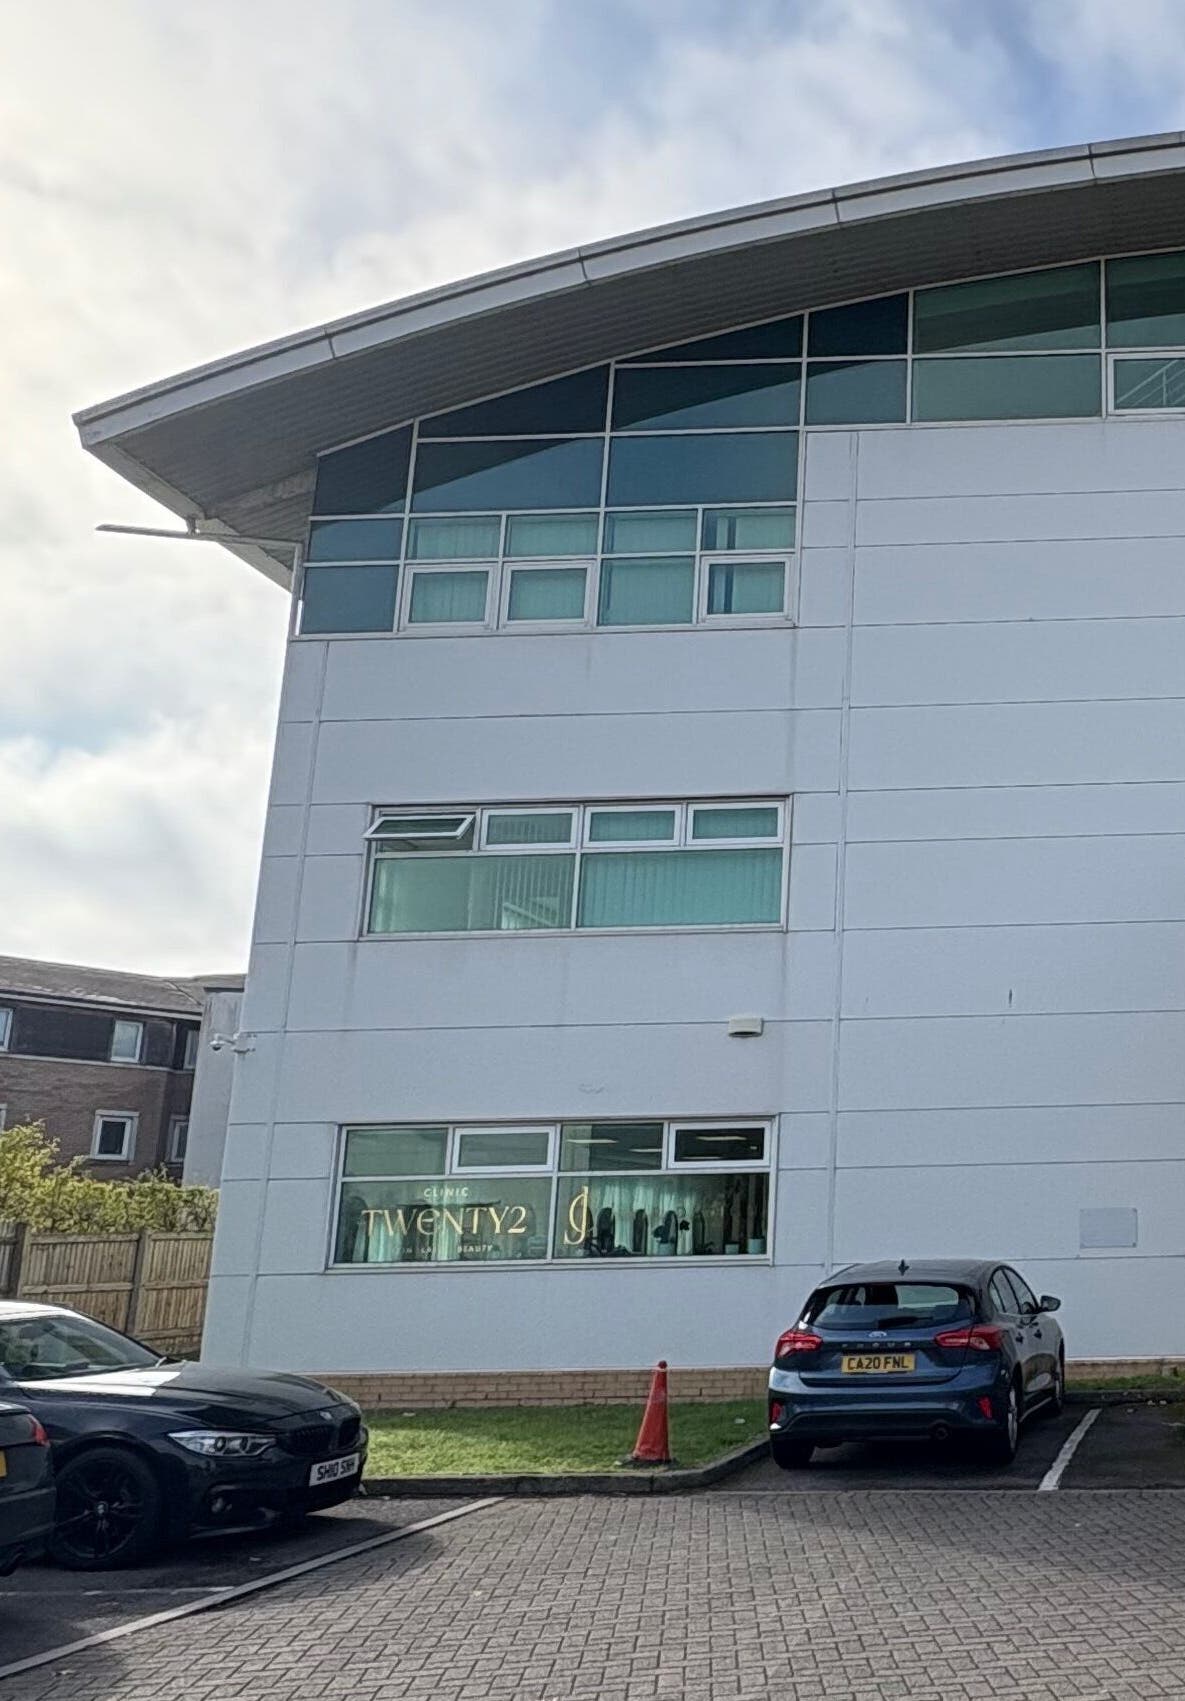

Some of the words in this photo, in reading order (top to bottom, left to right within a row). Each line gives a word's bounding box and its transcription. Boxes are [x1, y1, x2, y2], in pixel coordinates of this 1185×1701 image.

[423, 1186, 470, 1198] CLINIC
[361, 1205, 528, 1236] TWENTY2
[847, 1356, 881, 1370] CA20
[883, 1355, 909, 1370] FNL
